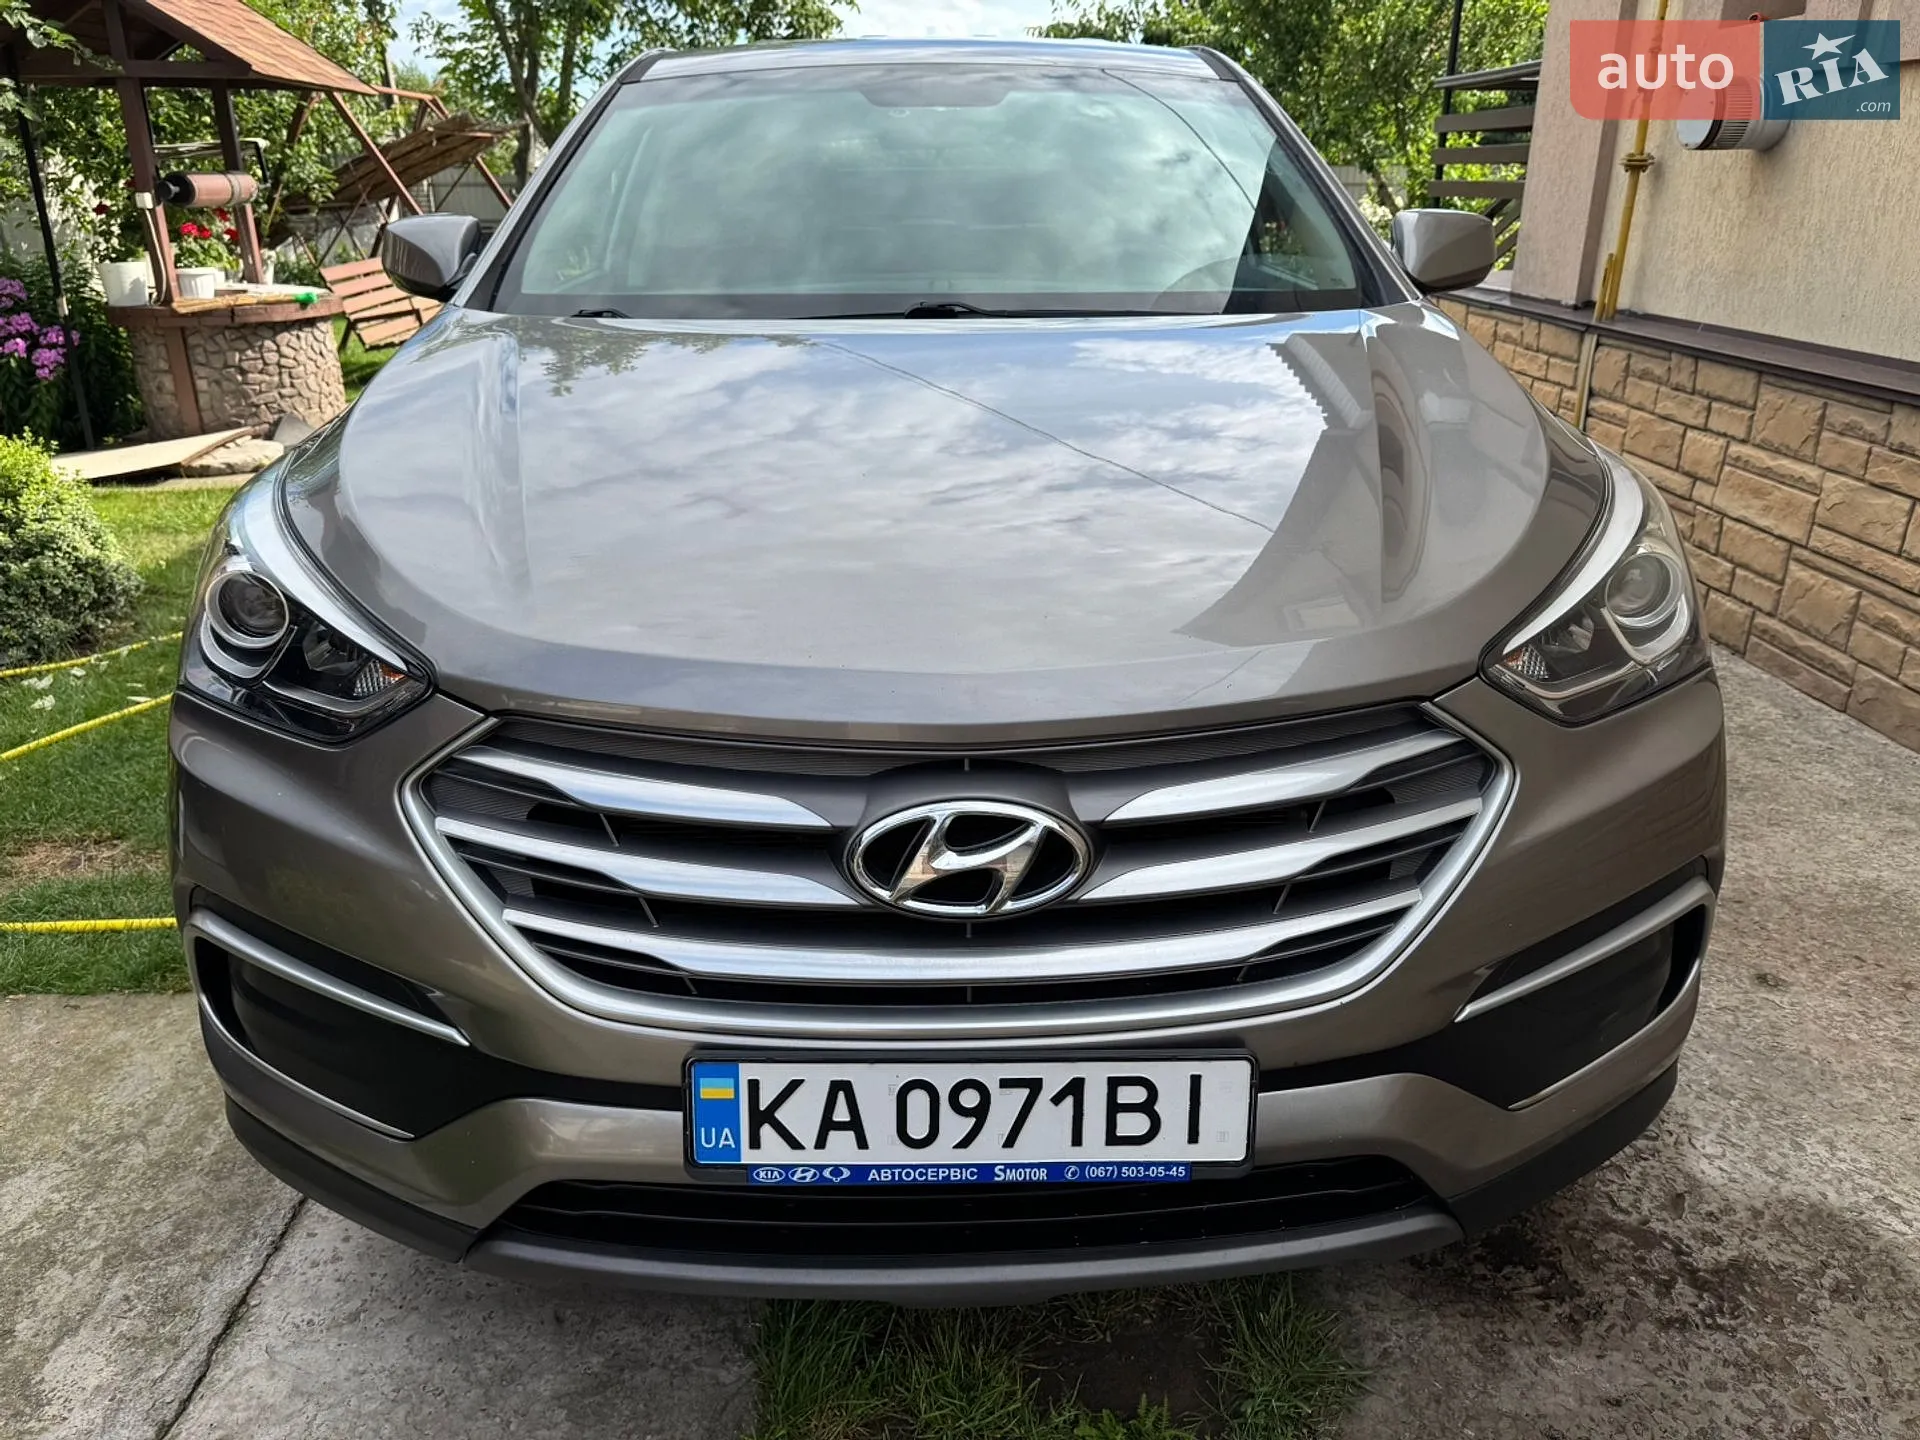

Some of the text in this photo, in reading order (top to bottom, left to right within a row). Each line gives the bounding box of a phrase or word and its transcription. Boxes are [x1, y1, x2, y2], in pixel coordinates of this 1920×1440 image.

[747, 1078, 869, 1150] KA
[701, 1127, 736, 1148] UA
[867, 1168, 978, 1181] АВТОСЕРВІС
[1085, 1165, 1118, 1179] (067)
[1121, 1165, 1186, 1178] 503-05-45
